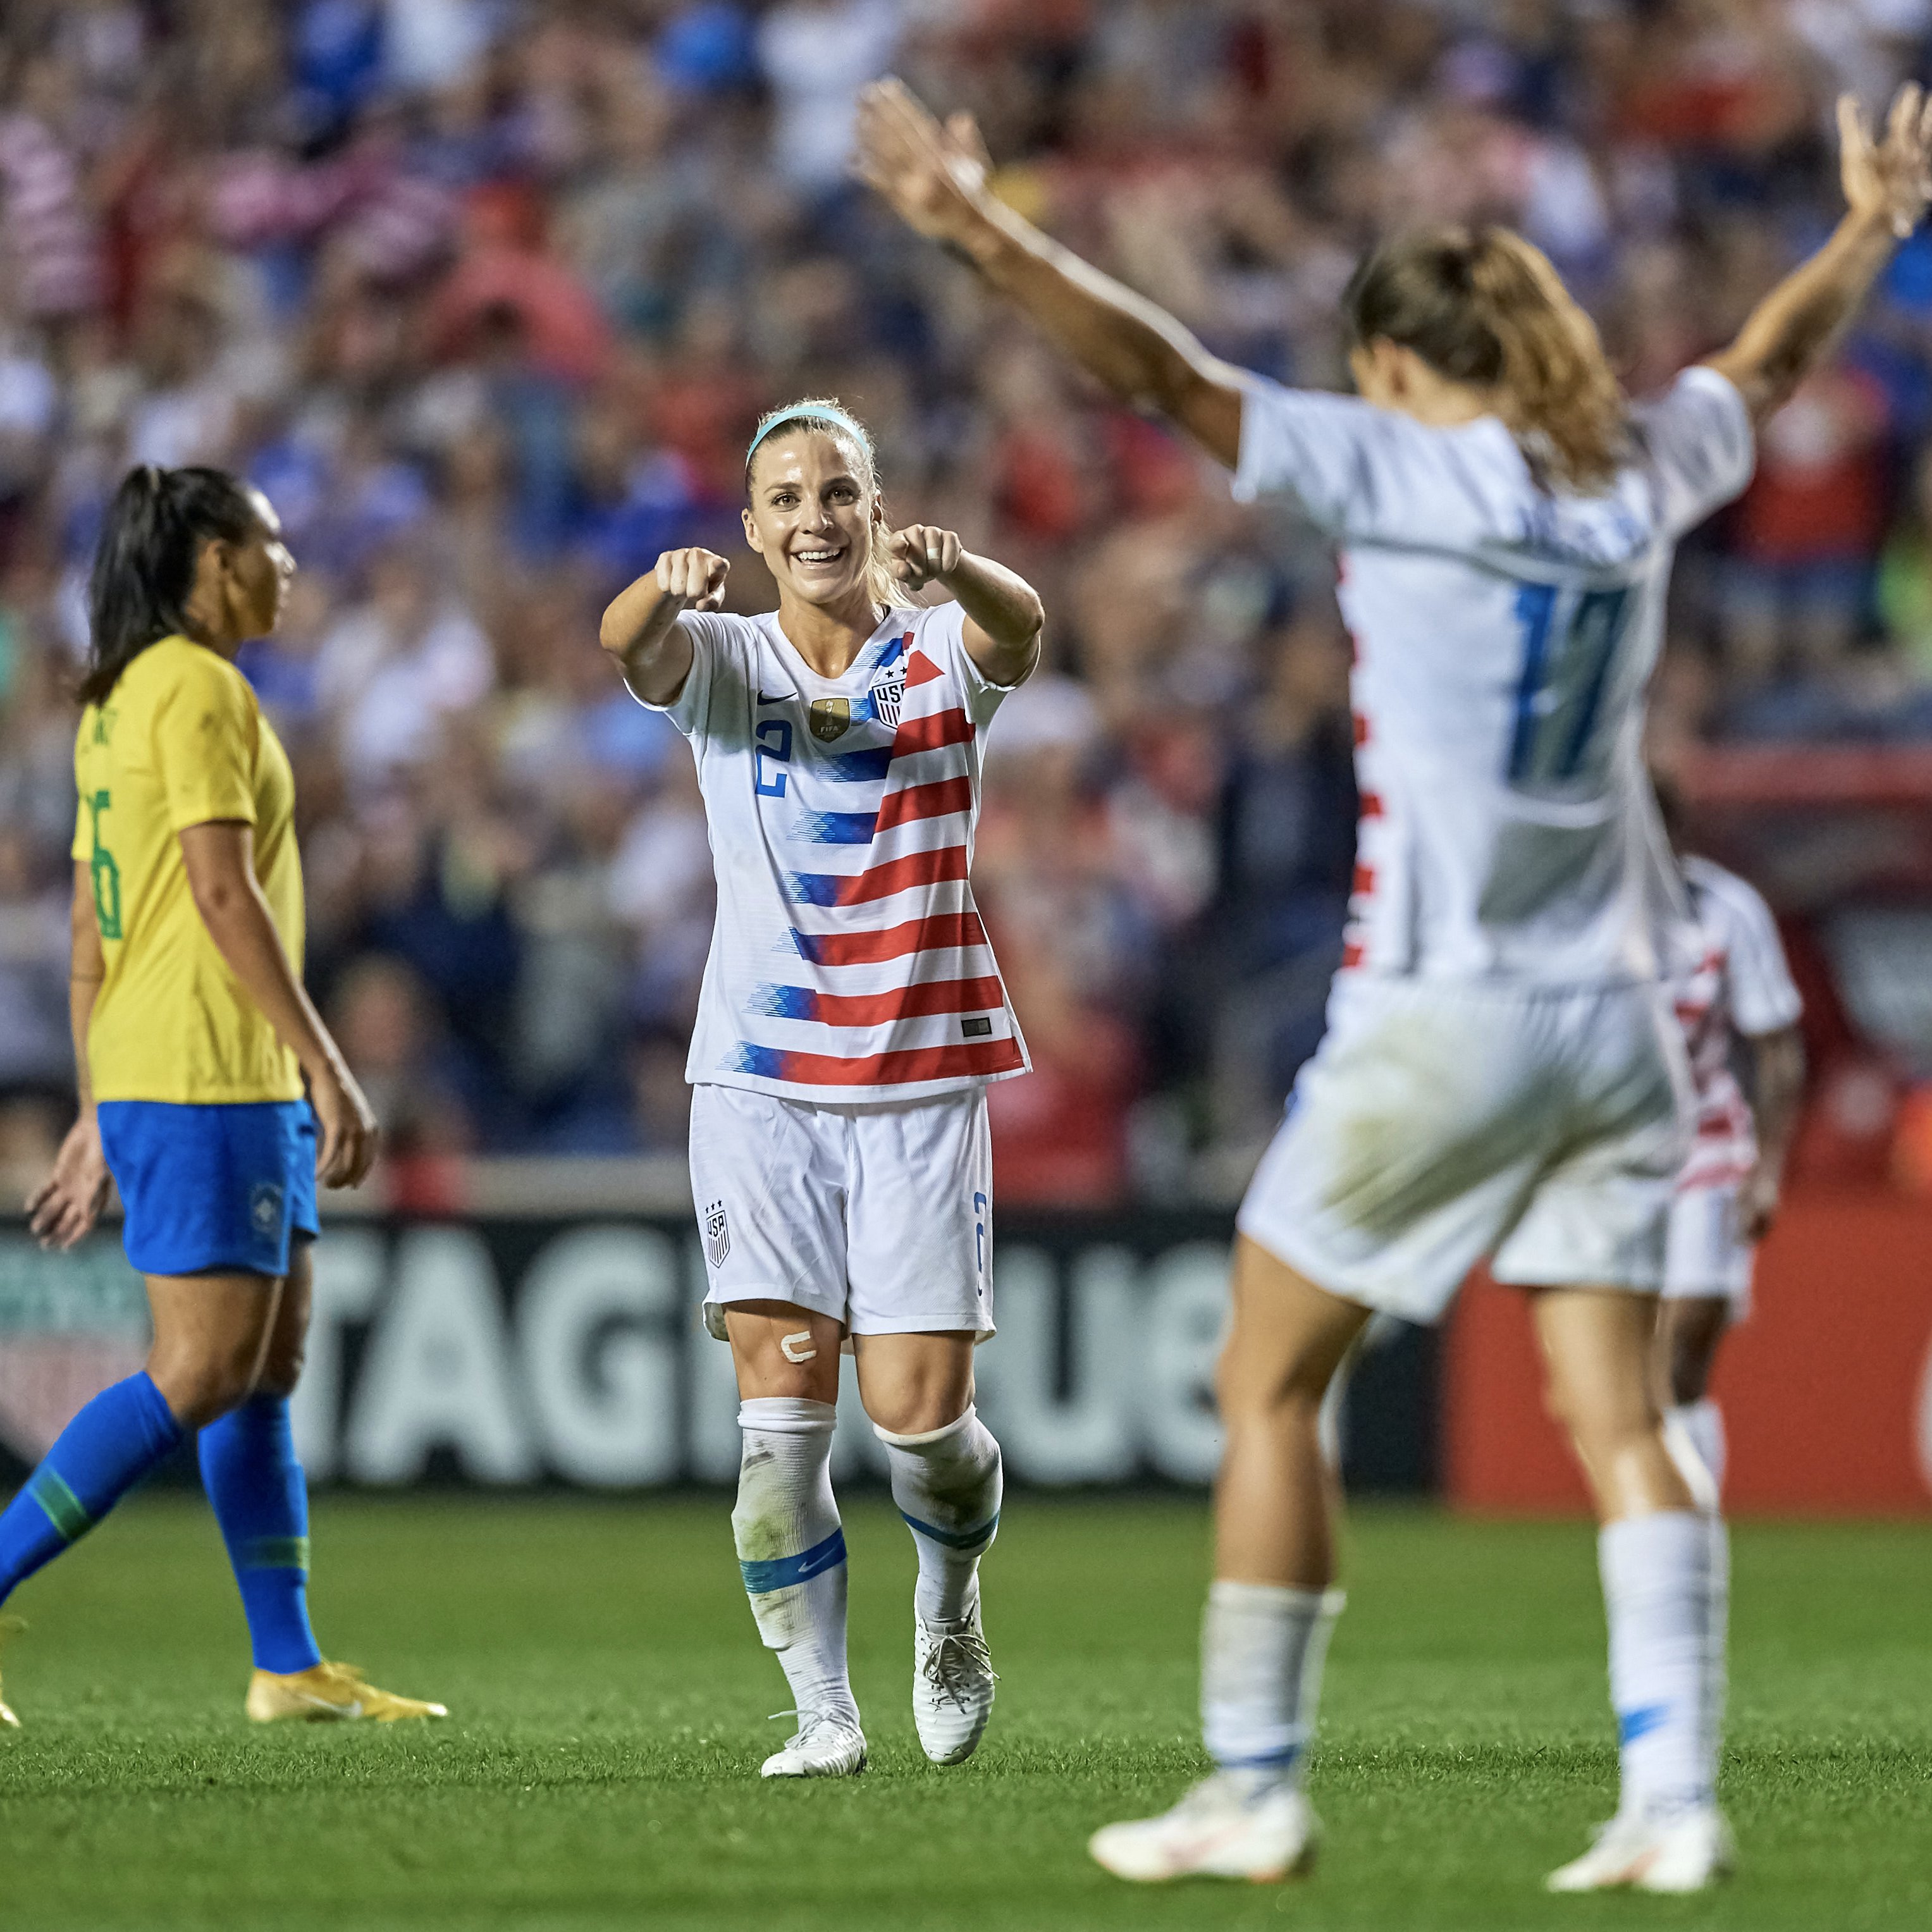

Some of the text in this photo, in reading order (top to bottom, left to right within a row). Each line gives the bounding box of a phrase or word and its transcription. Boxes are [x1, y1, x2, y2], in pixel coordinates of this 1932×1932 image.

[1508, 583, 1629, 783] 17
[754, 720, 792, 798] 2
[90, 791, 122, 938] 6
[708, 1214, 724, 1238] USA
